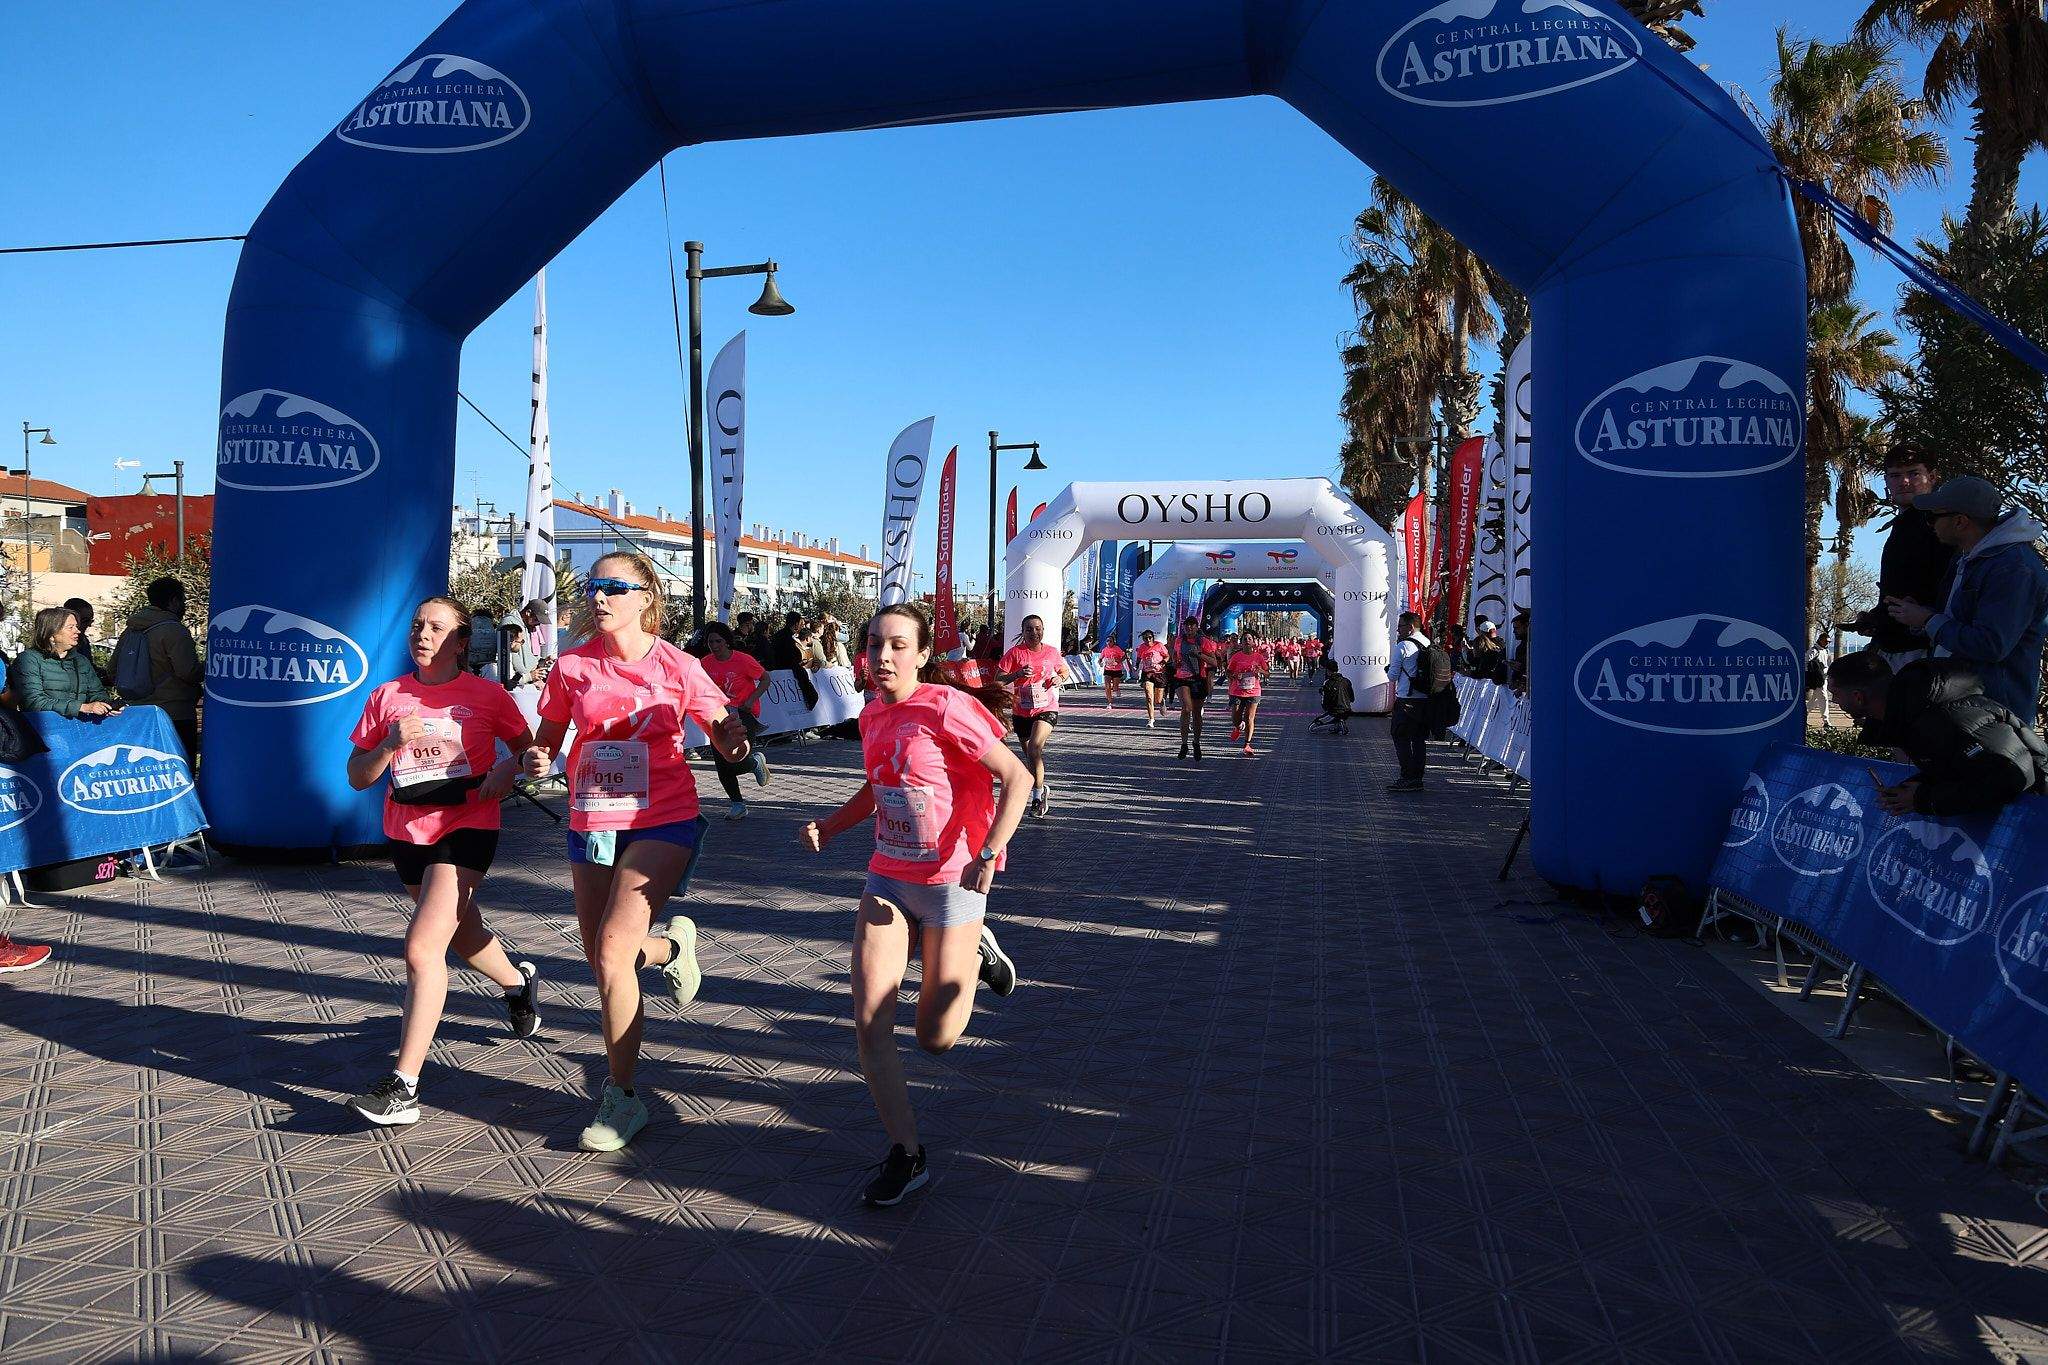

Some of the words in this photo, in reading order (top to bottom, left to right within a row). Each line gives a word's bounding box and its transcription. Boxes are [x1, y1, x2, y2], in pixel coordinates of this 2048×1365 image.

[1435, 22, 1522, 45] CENTRAL
[1397, 35, 1628, 89] ASTURIANA
[376, 86, 430, 102] CENTRAL
[436, 84, 504, 96] LECHERA
[342, 99, 514, 133] ASTURIANA
[1630, 399, 1718, 413] CENTRAL
[1727, 398, 1791, 411] LECHERA
[225, 424, 274, 435] CENTRAL
[282, 425, 356, 441] LECHERA
[1591, 407, 1795, 453] ASTURIANA
[1117, 491, 1272, 524] OYSHO
[1455, 463, 1472, 560] Santander
[938, 475, 950, 562] Santander
[1029, 529, 1073, 540] OYSHO
[1317, 525, 1365, 536] OYSHO
[1009, 589, 1049, 600] OYSHO
[1120, 569, 1133, 610] Marlene
[1343, 590, 1388, 602] OYSHO
[214, 638, 262, 650] CENTRAL
[269, 641, 344, 654] LECHERA
[205, 640, 351, 684] ASTURIANA
[1342, 655, 1387, 666] OYSHO
[1629, 656, 1716, 667] CENTRAL
[1725, 656, 1790, 667] LECHERA
[830, 673, 855, 697] OYS
[1590, 657, 1794, 703] ASTURIANA
[413, 746, 441, 759] 016
[73, 771, 189, 802] ASTURIANA
[594, 772, 624, 784] 016
[887, 819, 911, 833] 016
